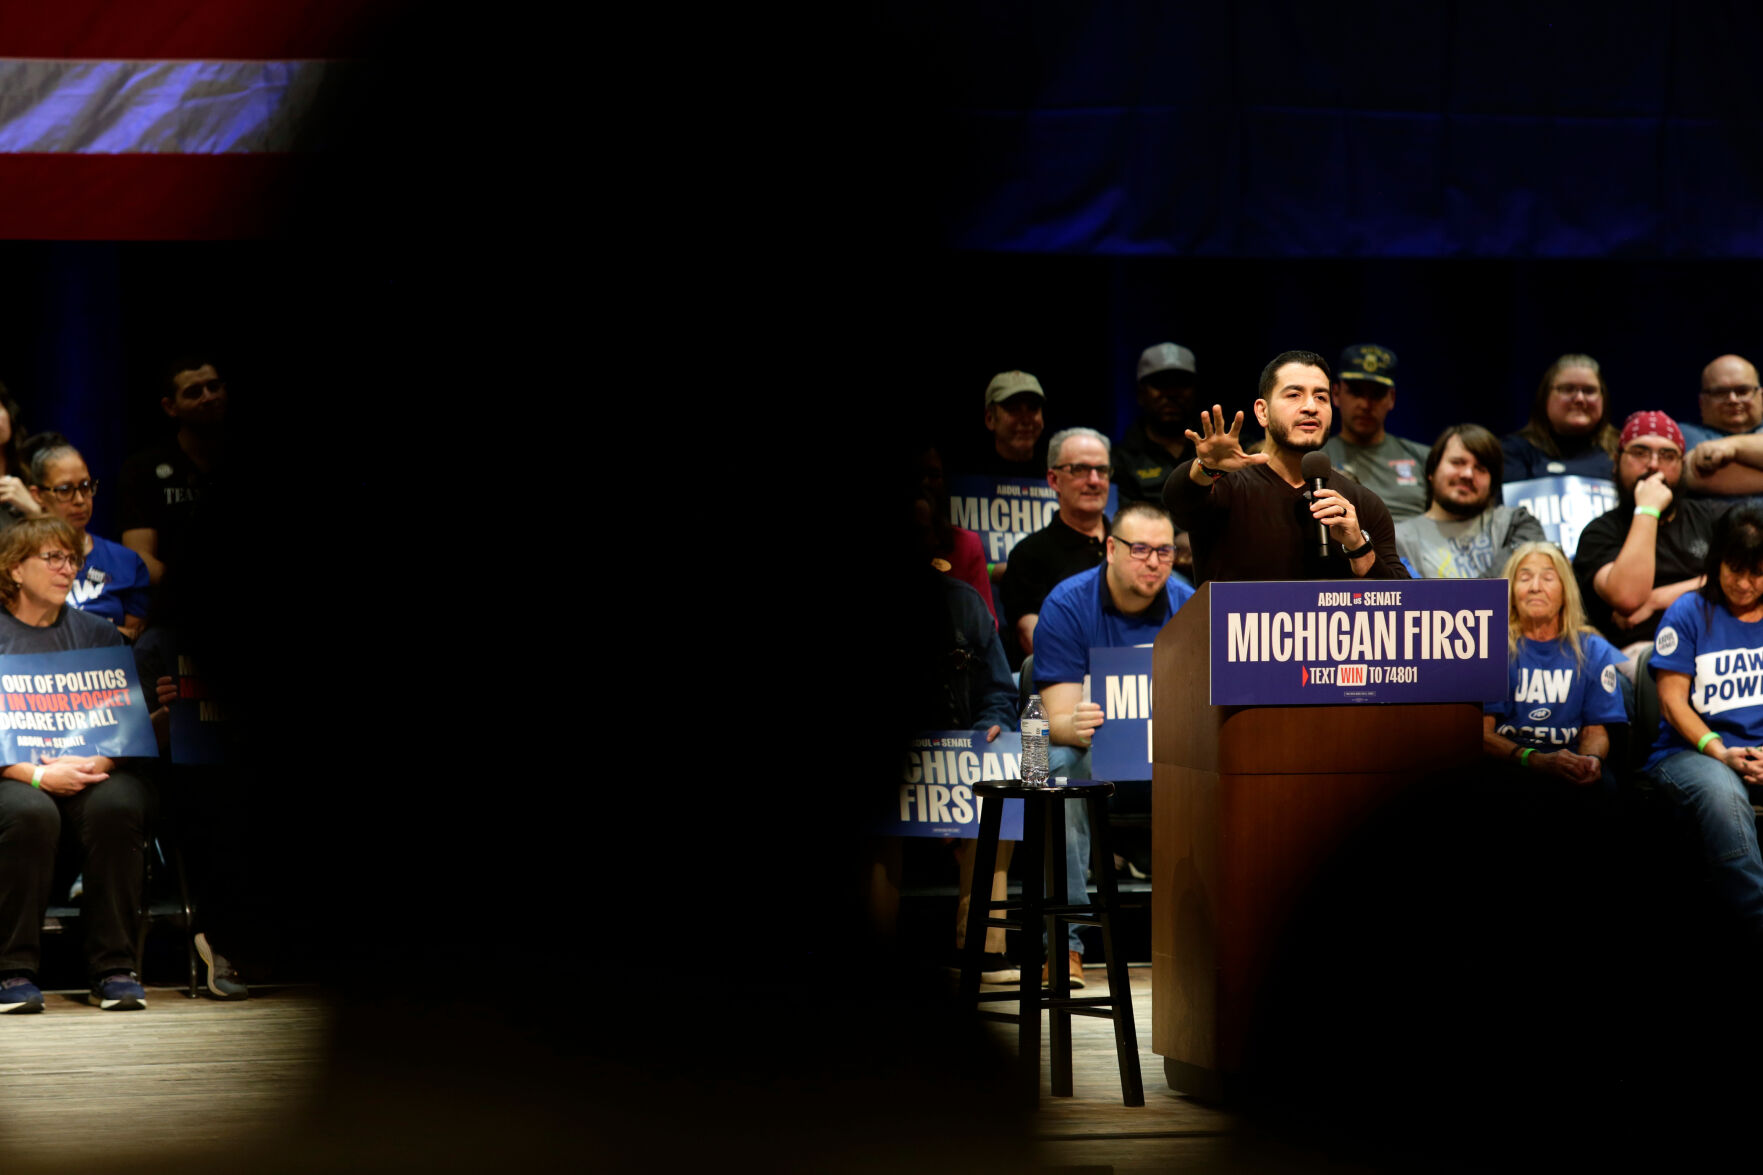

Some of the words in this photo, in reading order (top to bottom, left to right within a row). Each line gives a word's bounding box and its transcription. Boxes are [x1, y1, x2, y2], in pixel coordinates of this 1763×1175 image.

[1318, 592, 1352, 606] ABDUL
[1364, 591, 1402, 606] SENATE
[1228, 611, 1397, 662] MICHIGAN
[1404, 609, 1493, 660] FIRST
[2, 674, 34, 693] OUT
[34, 674, 54, 693] OF
[55, 668, 128, 692] POLITICS
[1310, 667, 1336, 684] TEXT
[1341, 667, 1363, 684] WIN
[1369, 667, 1382, 684] TO
[1384, 666, 1418, 684] 74801
[6, 693, 27, 711] IN
[25, 693, 71, 713] YOUR
[69, 688, 132, 711] POCKET
[1106, 674, 1152, 719] MI
[1704, 676, 1763, 705] POW
[55, 711, 89, 731] FOR
[88, 708, 119, 729] ALL
[941, 738, 973, 748] SENATE
